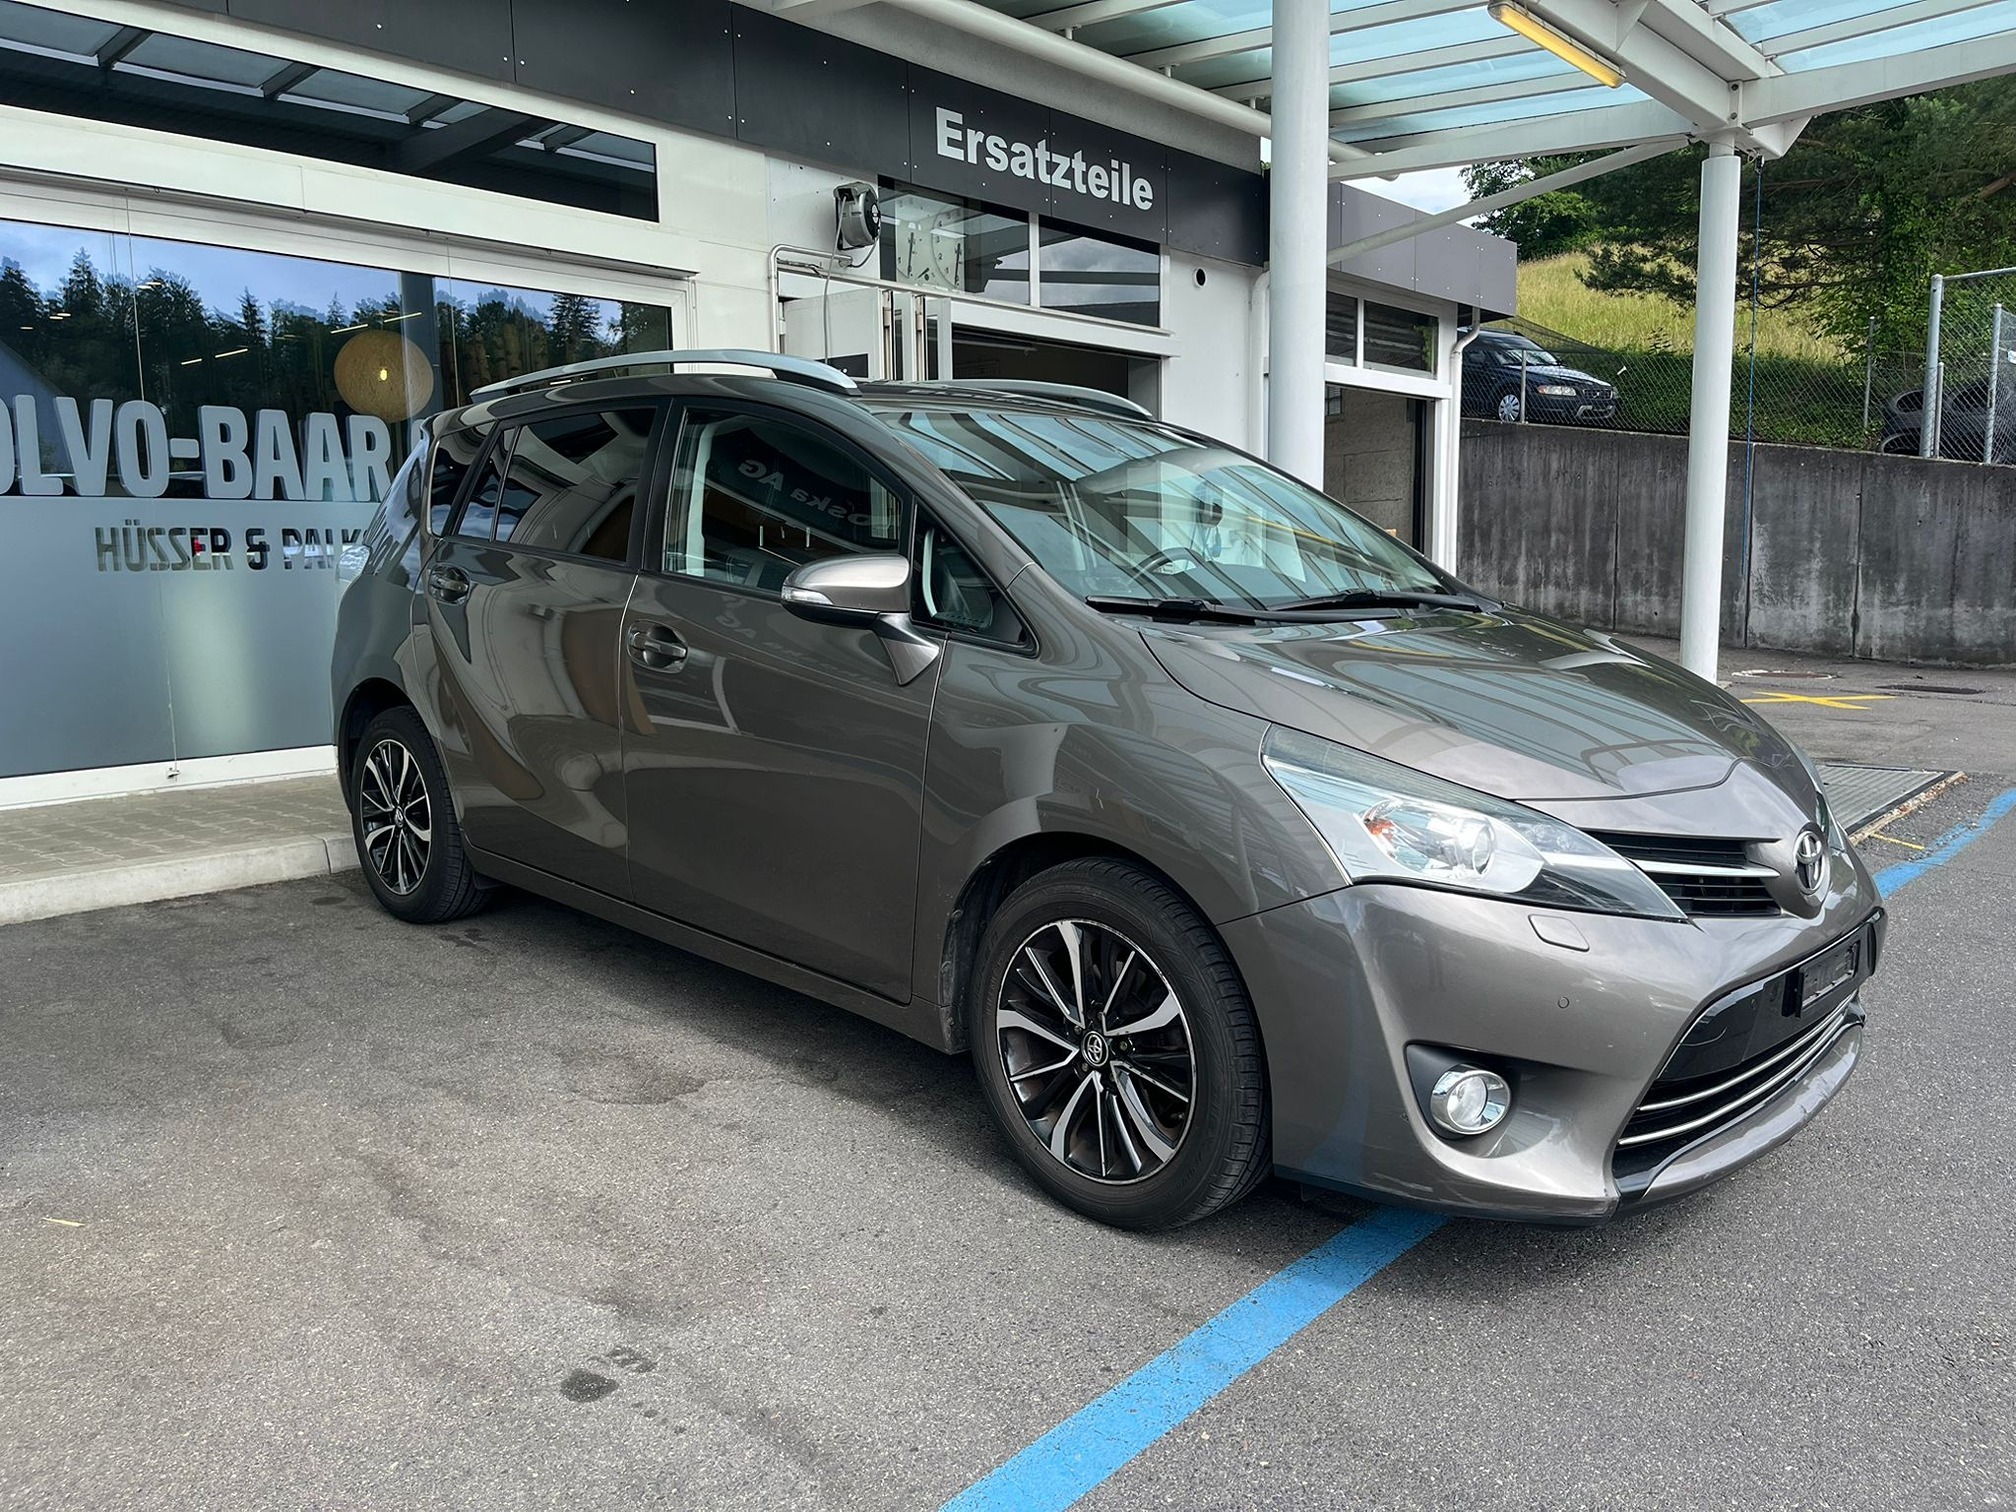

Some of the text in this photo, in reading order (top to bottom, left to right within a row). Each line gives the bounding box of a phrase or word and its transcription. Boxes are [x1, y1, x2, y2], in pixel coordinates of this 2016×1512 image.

[935, 106, 1154, 211] Ersatzteile
[0, 394, 391, 502] LVO-BAAR
[95, 519, 234, 572] HÜSSER
[245, 528, 270, 570] &
